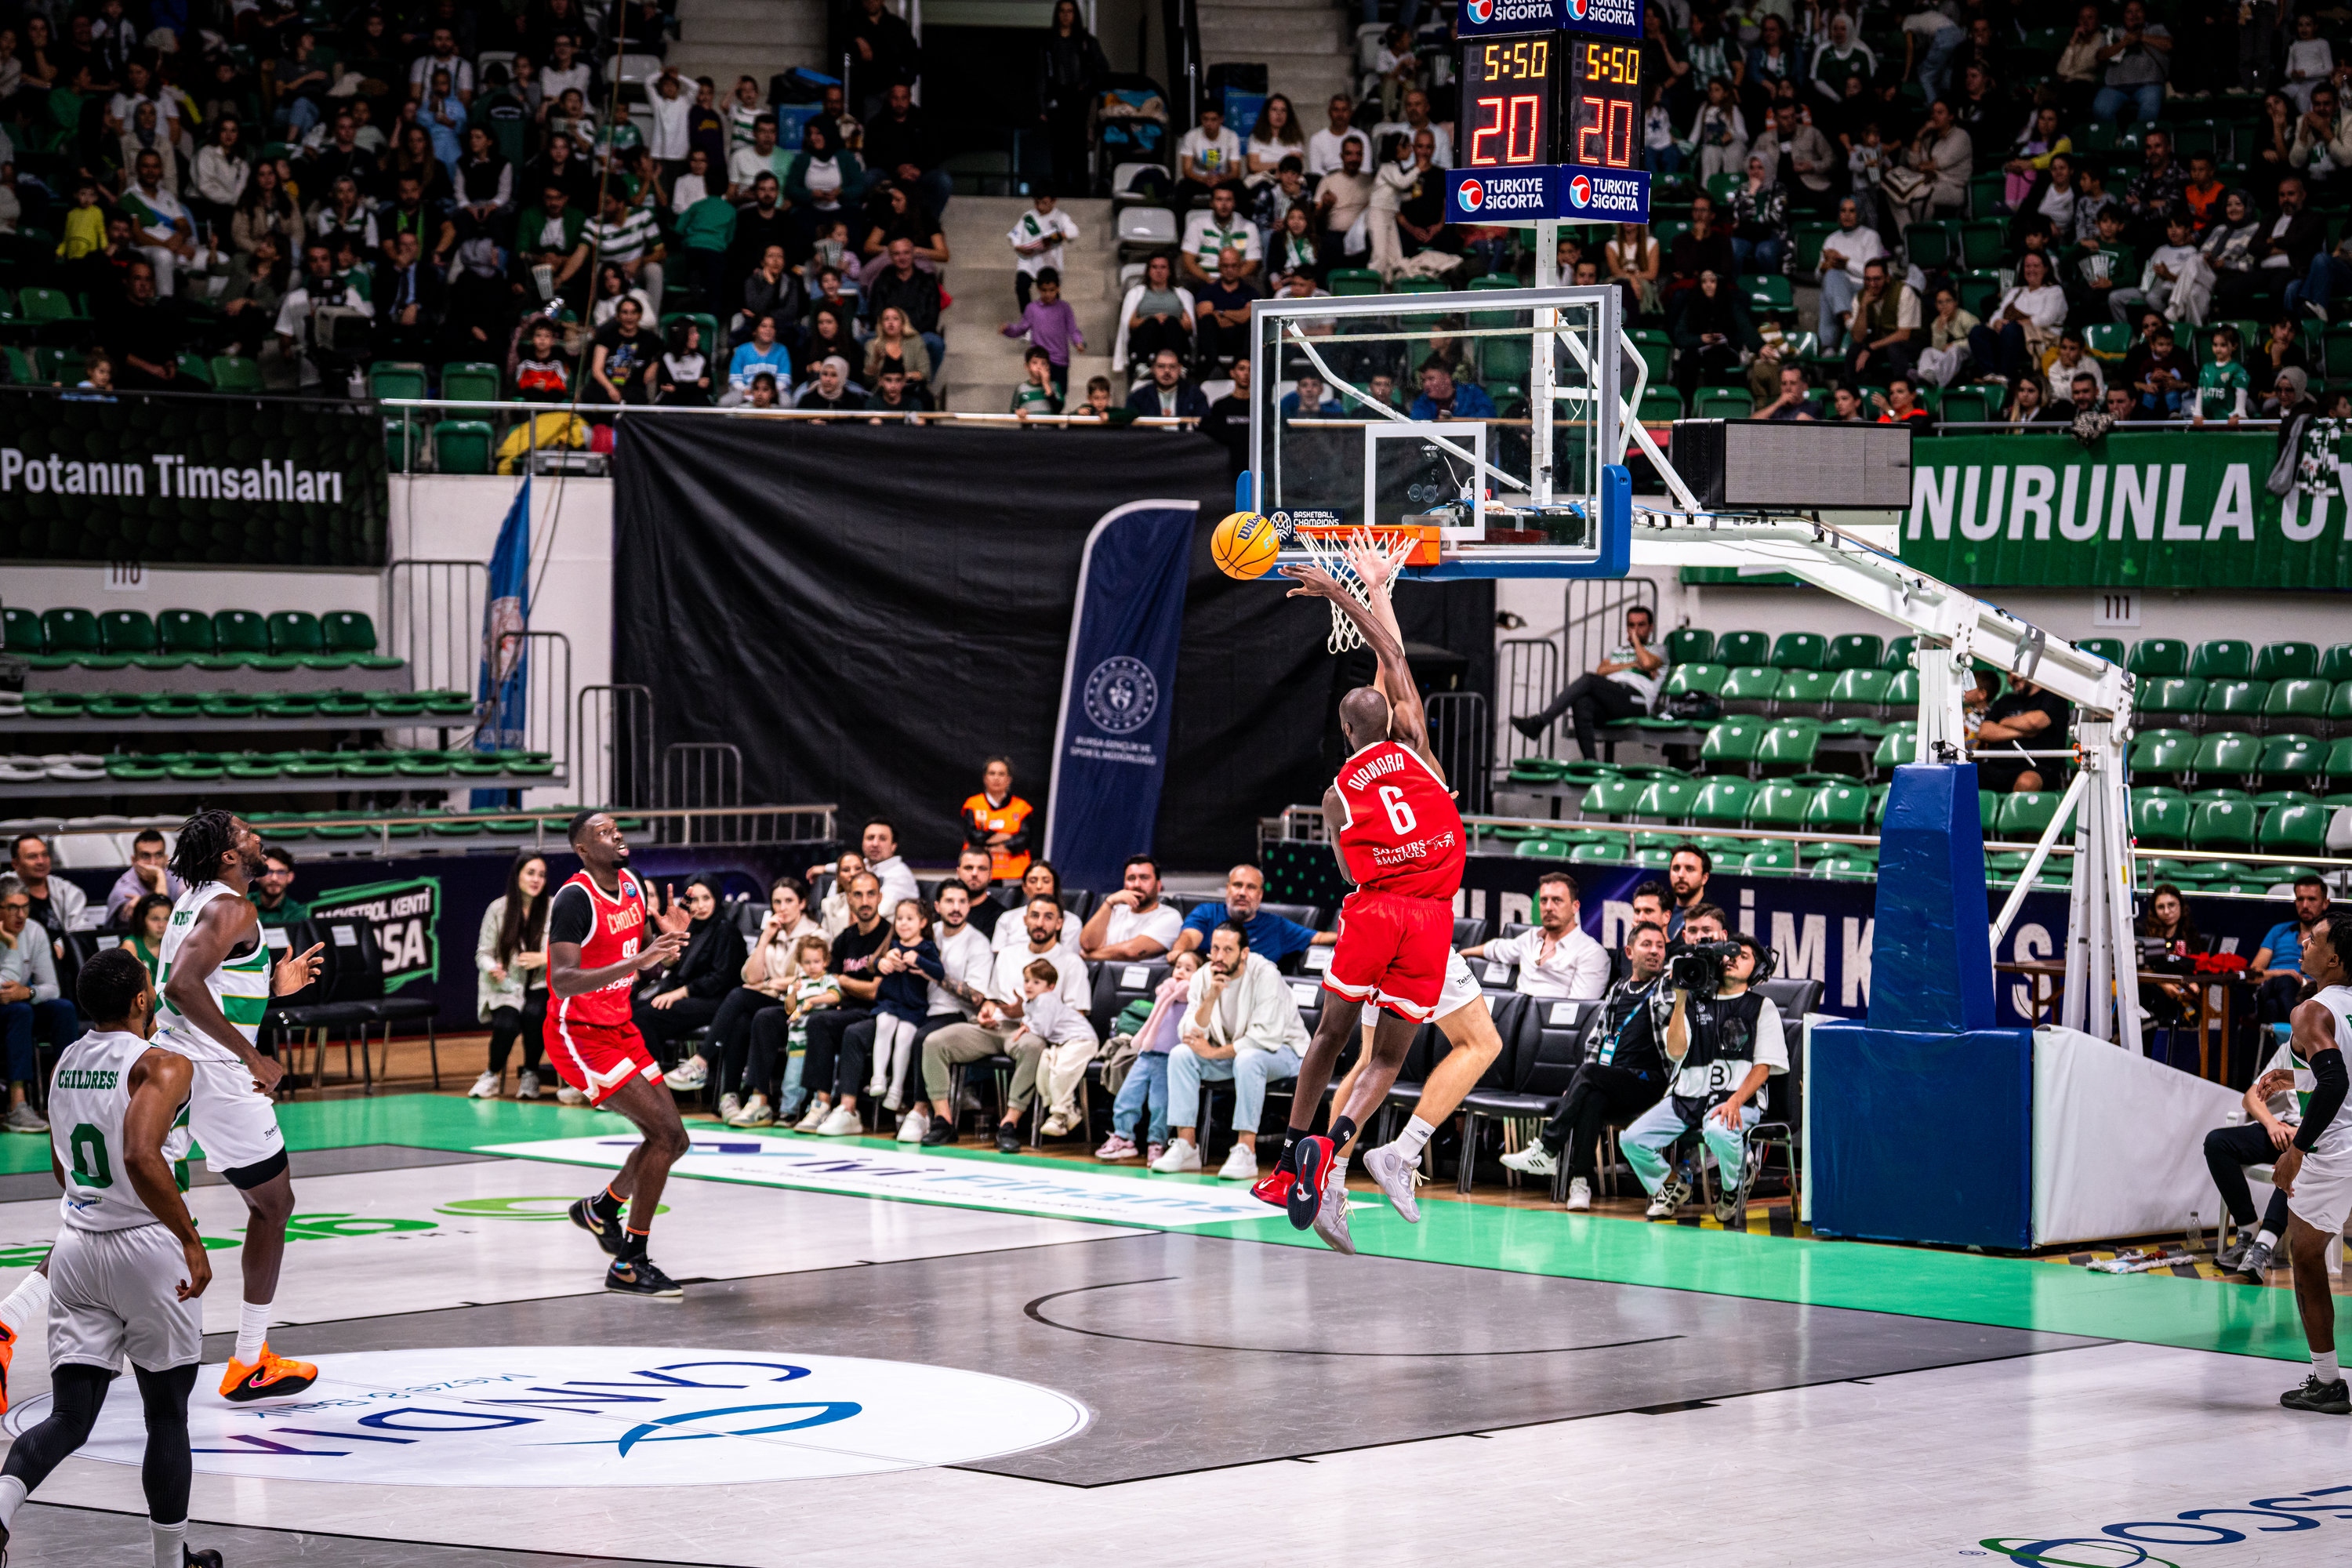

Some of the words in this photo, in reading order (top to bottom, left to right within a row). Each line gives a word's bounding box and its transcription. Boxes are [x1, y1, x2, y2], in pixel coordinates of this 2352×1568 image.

[1484, 42, 1548, 81] 5:50
[1586, 44, 1639, 85] 5:50
[1471, 95, 1538, 165] 20
[1579, 96, 1633, 167] 20
[2, 448, 144, 496] Potanın
[152, 455, 343, 504] Timsahları
[1907, 463, 2256, 542] NURUNLA
[1348, 753, 1405, 791] DIAWARA
[1378, 786, 1417, 836] 6
[1382, 847, 1427, 865] MAUGES
[607, 902, 643, 935] CHOLET
[58, 1069, 119, 1090] CHILDRESS
[70, 1123, 114, 1189] 0
[405, 1373, 537, 1393] Meze
